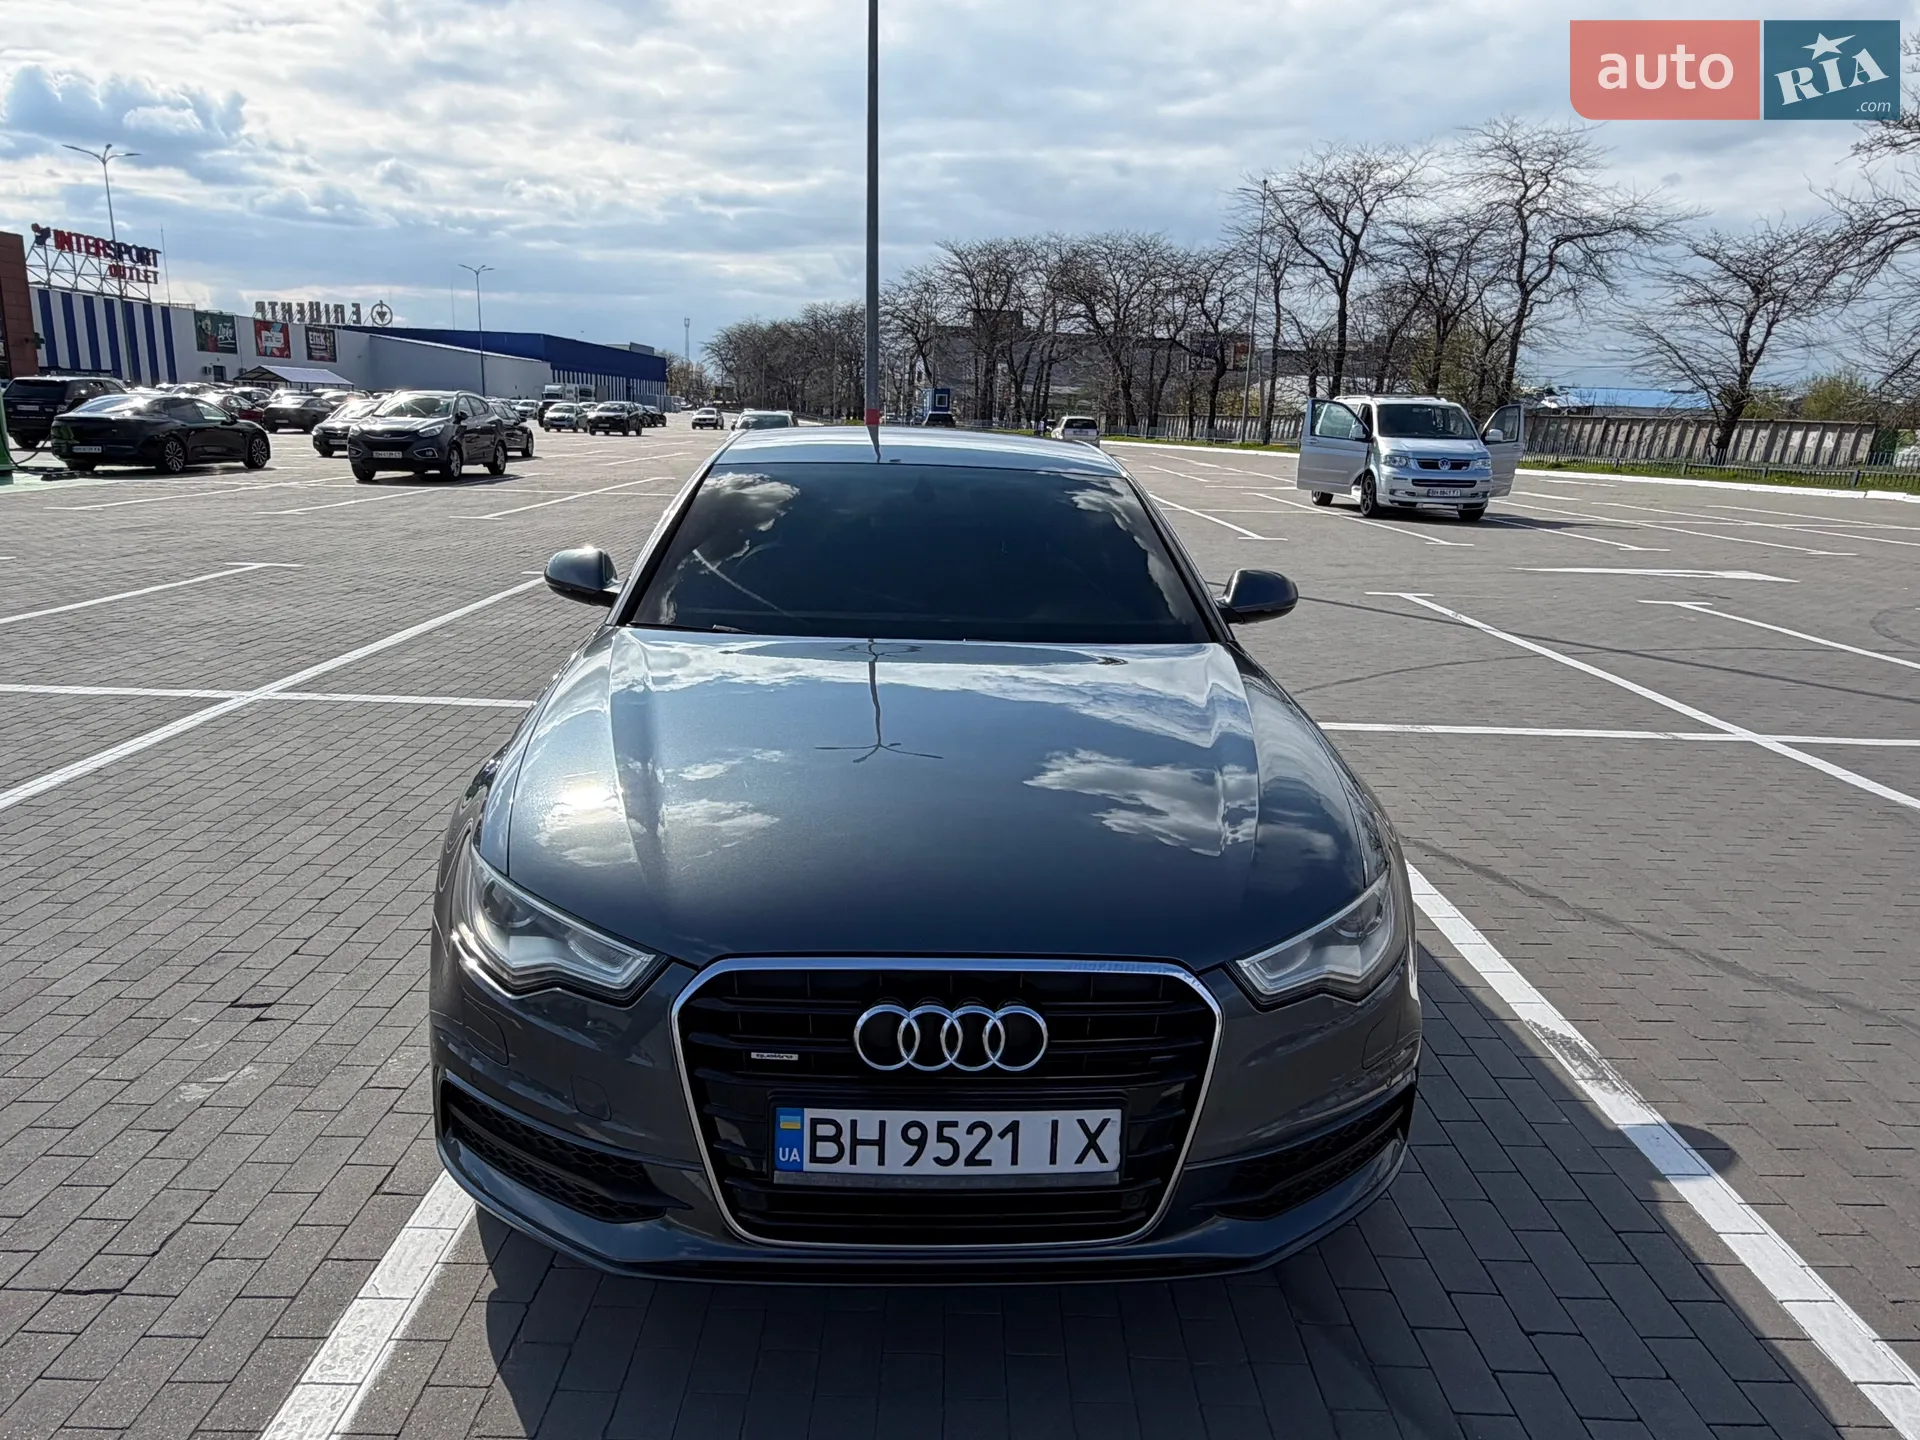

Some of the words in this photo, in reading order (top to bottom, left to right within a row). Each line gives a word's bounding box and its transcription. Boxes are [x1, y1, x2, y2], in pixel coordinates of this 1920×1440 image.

[52, 229, 161, 267] INTERSPORT
[108, 263, 159, 284] OUTLET
[778, 1147, 801, 1163] UA
[808, 1117, 887, 1166] BH
[900, 1119, 1019, 1167] 9521
[1048, 1117, 1112, 1165] IX
